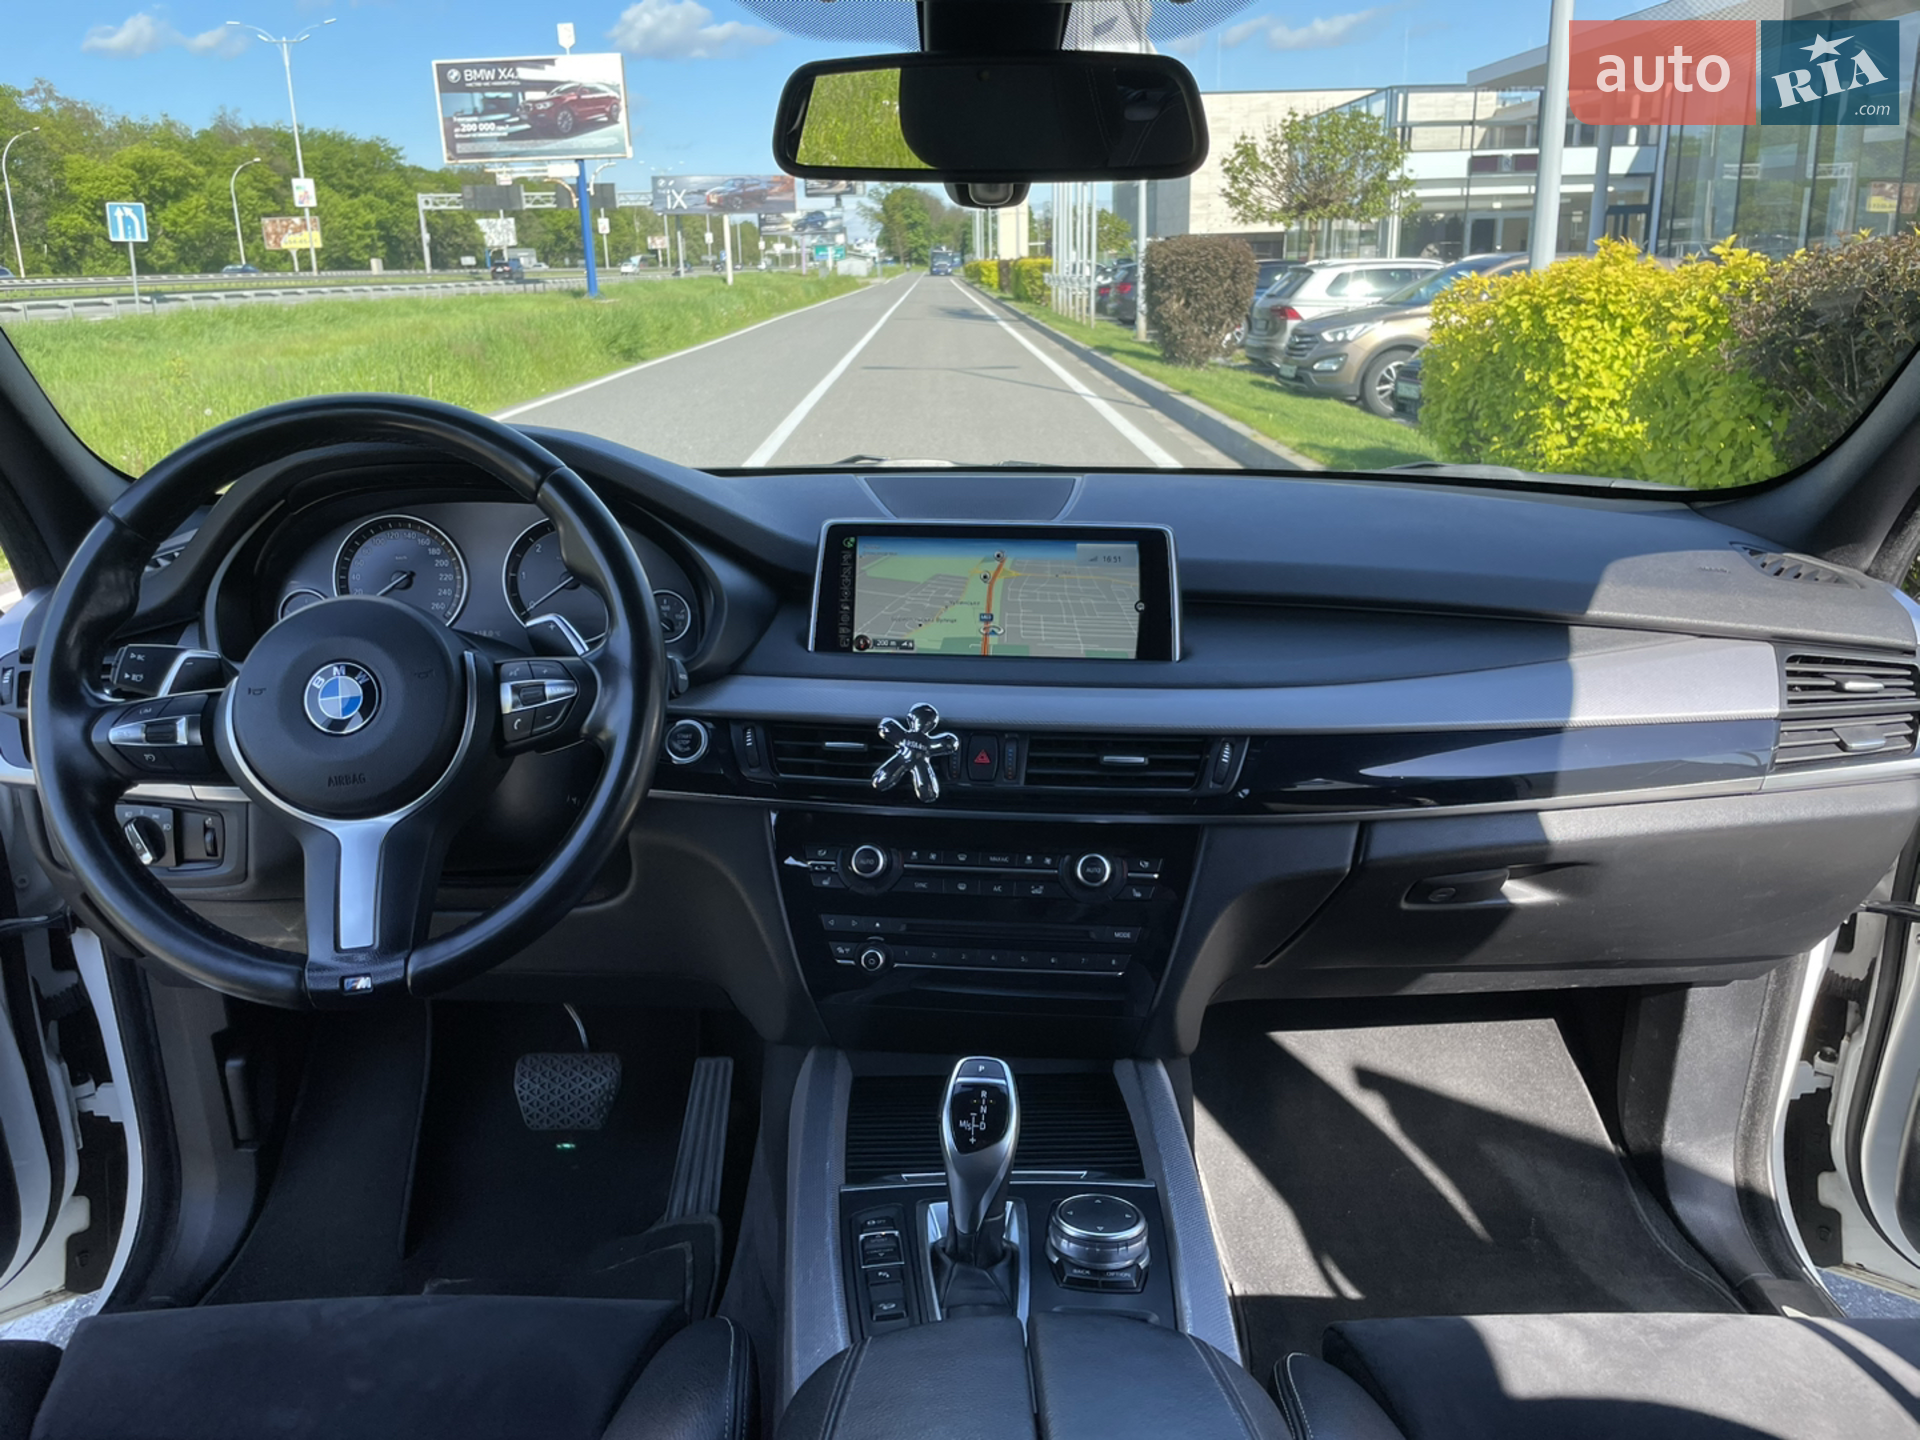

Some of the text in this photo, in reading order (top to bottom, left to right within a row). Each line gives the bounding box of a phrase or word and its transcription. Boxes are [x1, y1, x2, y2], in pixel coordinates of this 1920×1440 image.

[463, 68, 496, 82] BMW
[460, 123, 478, 133] 200
[478, 122, 496, 132] 000
[666, 188, 688, 210] iX
[417, 538, 431, 546] 160
[535, 544, 542, 553] 2
[435, 559, 449, 567] 200
[351, 573, 361, 581] 40
[439, 573, 453, 581] 220
[431, 602, 446, 610] 260
[312, 665, 369, 689] BMW
[326, 774, 367, 788] AIRBAG
[1085, 866, 1102, 874] AUTO
[914, 881, 928, 889] SYNC
[1114, 931, 1132, 939] MODE
[981, 1090, 987, 1098] R
[980, 1105, 987, 1114] N
[979, 1121, 986, 1131] D
